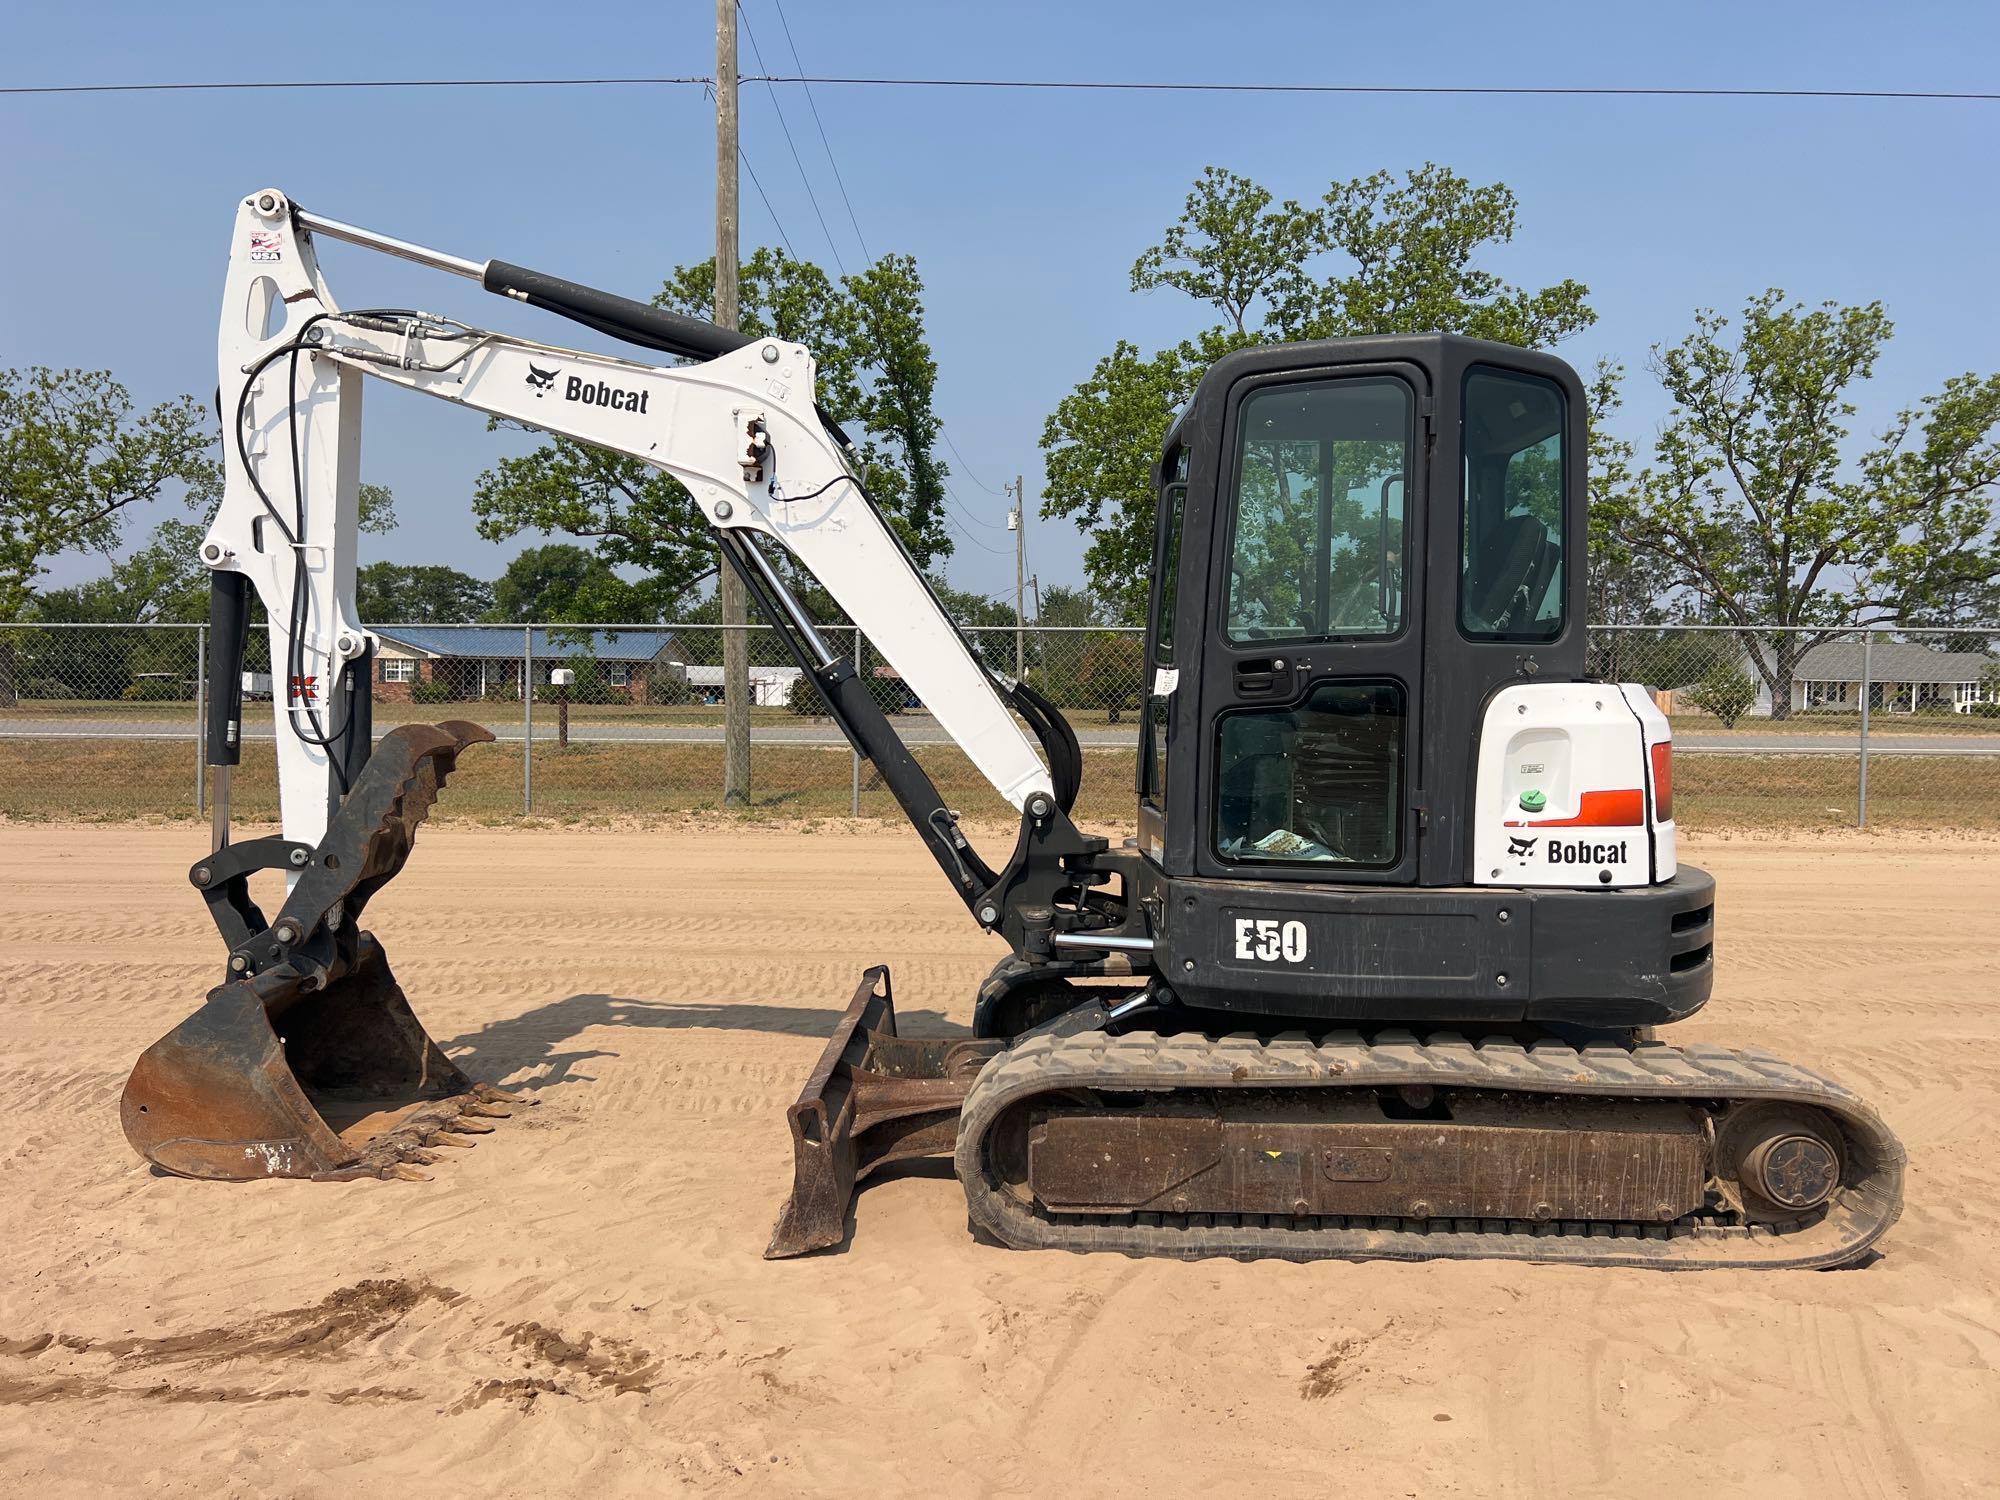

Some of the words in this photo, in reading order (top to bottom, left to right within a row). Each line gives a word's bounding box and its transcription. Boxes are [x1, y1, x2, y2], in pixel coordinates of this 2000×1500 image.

[251, 252, 279, 260] USA
[565, 376, 649, 414] Bobcat
[1548, 840, 1627, 864] Bobcat
[1235, 918, 1308, 963] E50
